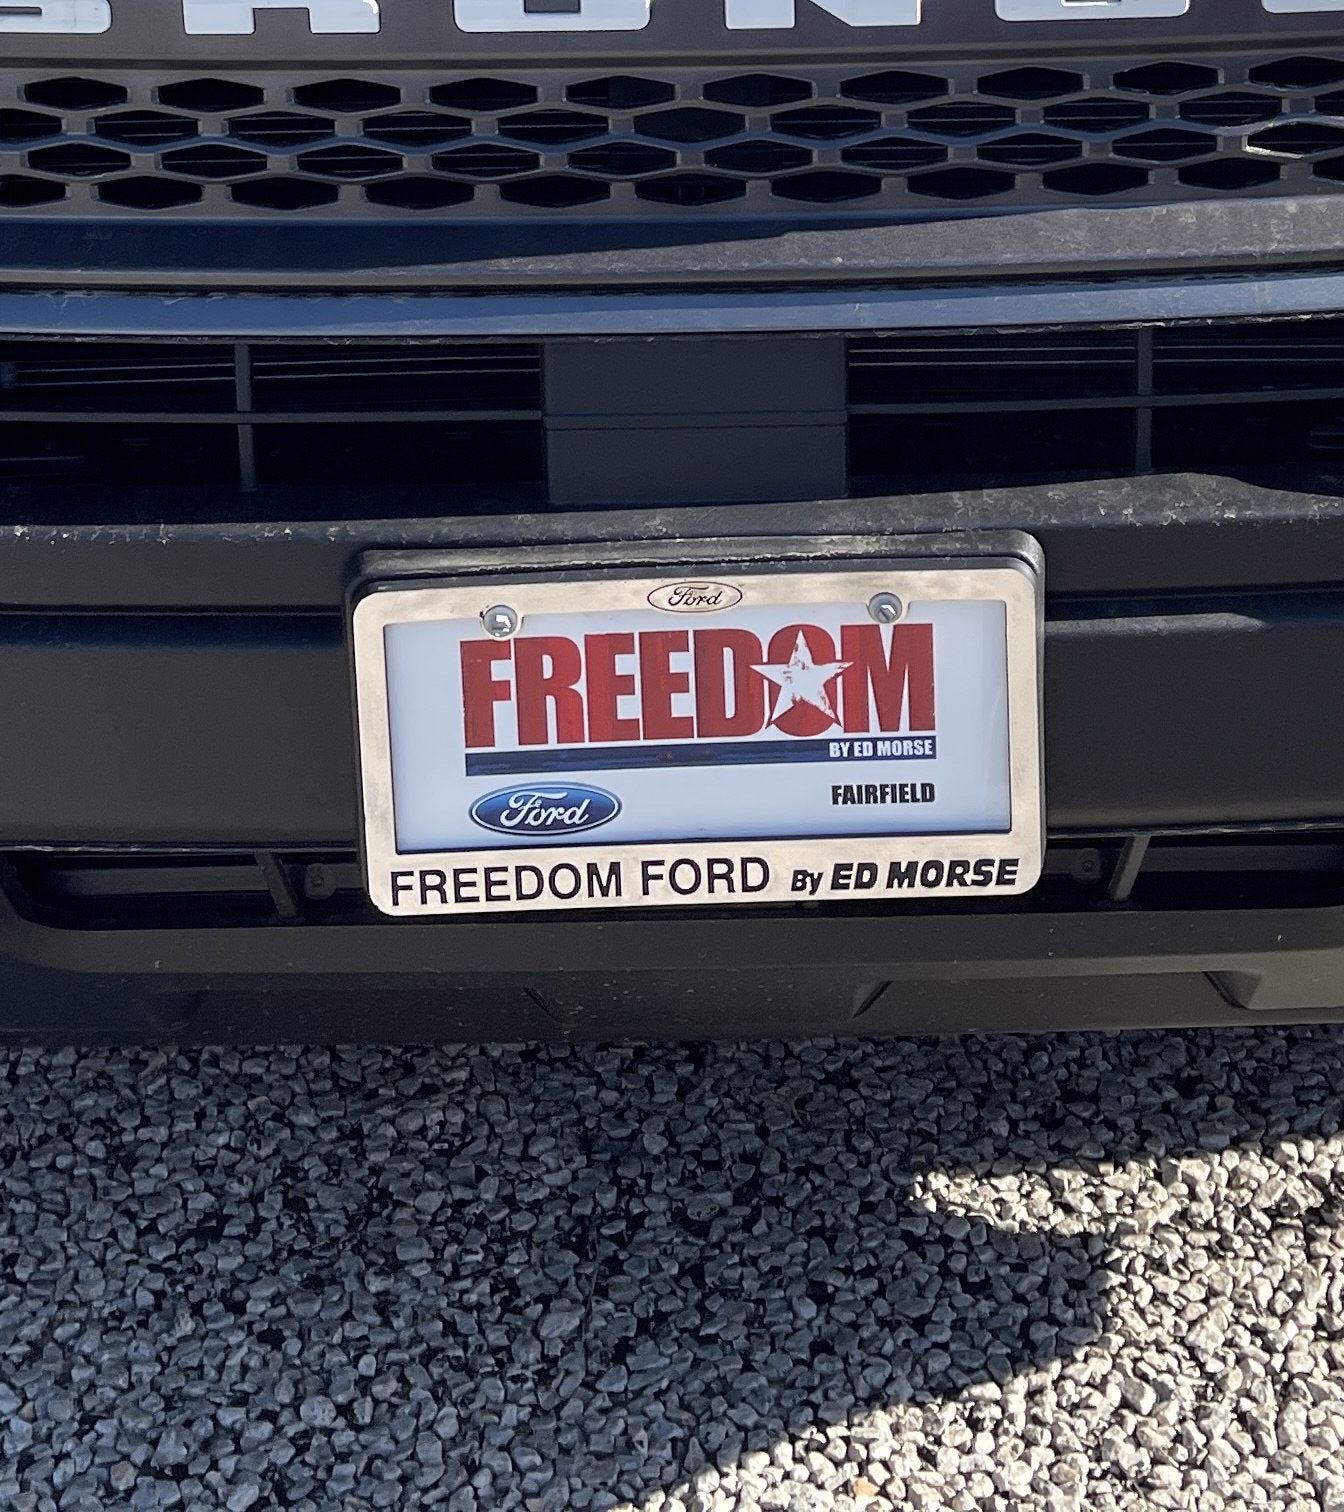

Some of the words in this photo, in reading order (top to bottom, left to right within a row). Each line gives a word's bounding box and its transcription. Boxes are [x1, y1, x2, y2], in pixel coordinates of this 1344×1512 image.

[668, 586, 723, 606] Ford
[460, 623, 936, 748] FREEDOM
[828, 742, 850, 758] BY
[853, 741, 874, 757] ED
[876, 739, 933, 757] MORSE
[499, 791, 590, 827] Ford
[831, 782, 936, 806] FAIRFIELD
[390, 860, 623, 907] FREEDOM
[640, 856, 770, 897] FORD
[790, 869, 824, 896] By
[830, 861, 878, 891] ED
[885, 857, 1020, 889] MORSE
